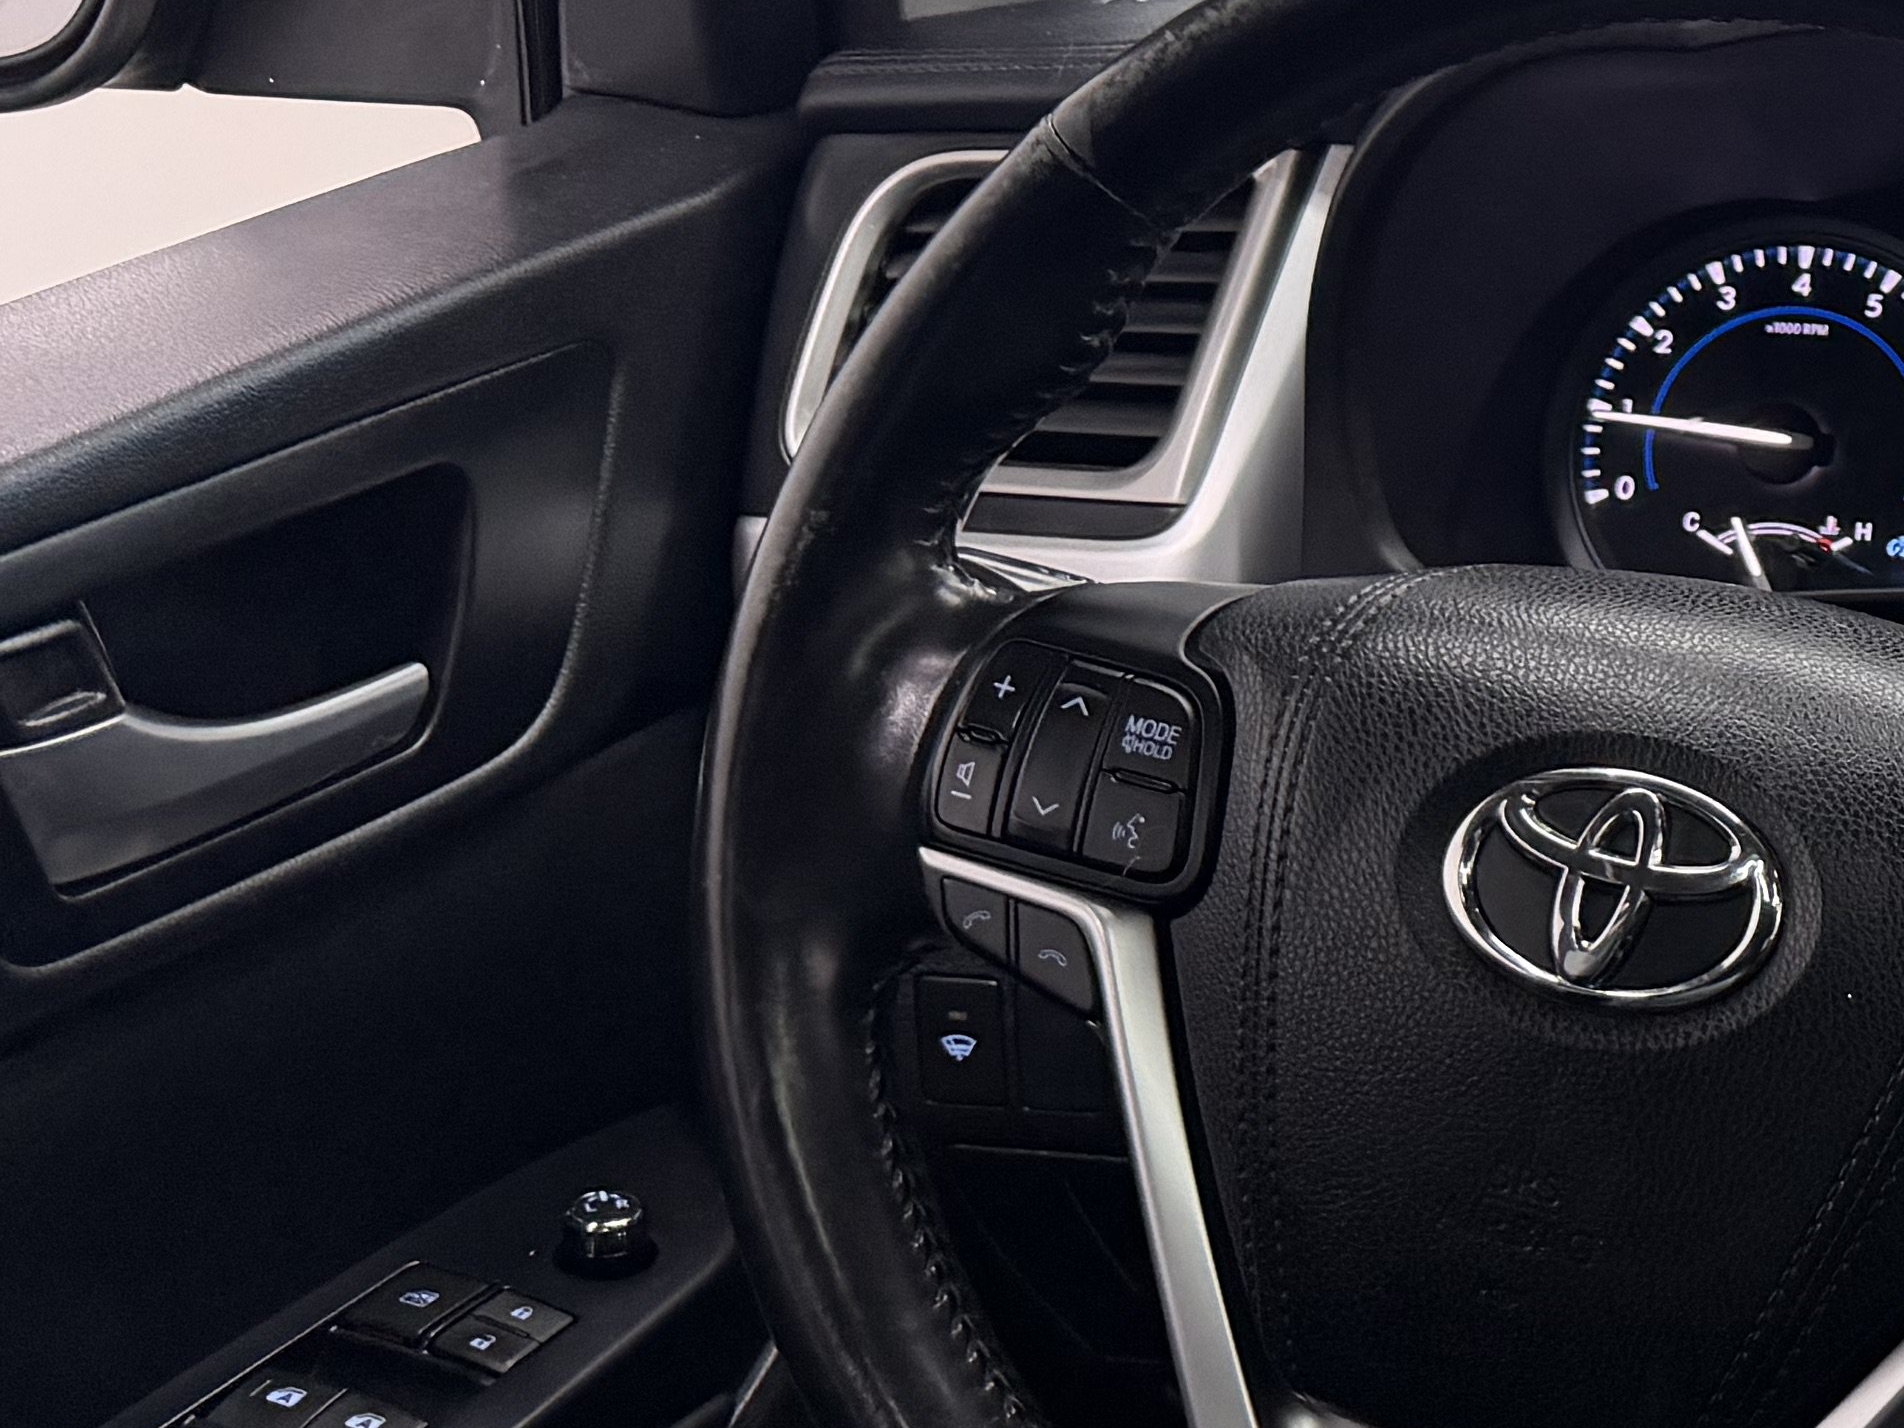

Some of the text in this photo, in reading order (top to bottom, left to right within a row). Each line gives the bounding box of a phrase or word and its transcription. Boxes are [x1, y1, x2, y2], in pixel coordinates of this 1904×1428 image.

[1792, 272, 1813, 297] 4
[1716, 285, 1737, 311] 3
[1864, 293, 1885, 319] 5
[1653, 329, 1675, 355] 2
[1614, 474, 1636, 502] 0
[1681, 510, 1701, 533] C
[1854, 522, 1873, 542] H
[1124, 714, 1183, 745] MODE
[1132, 737, 1174, 760] HOLD
